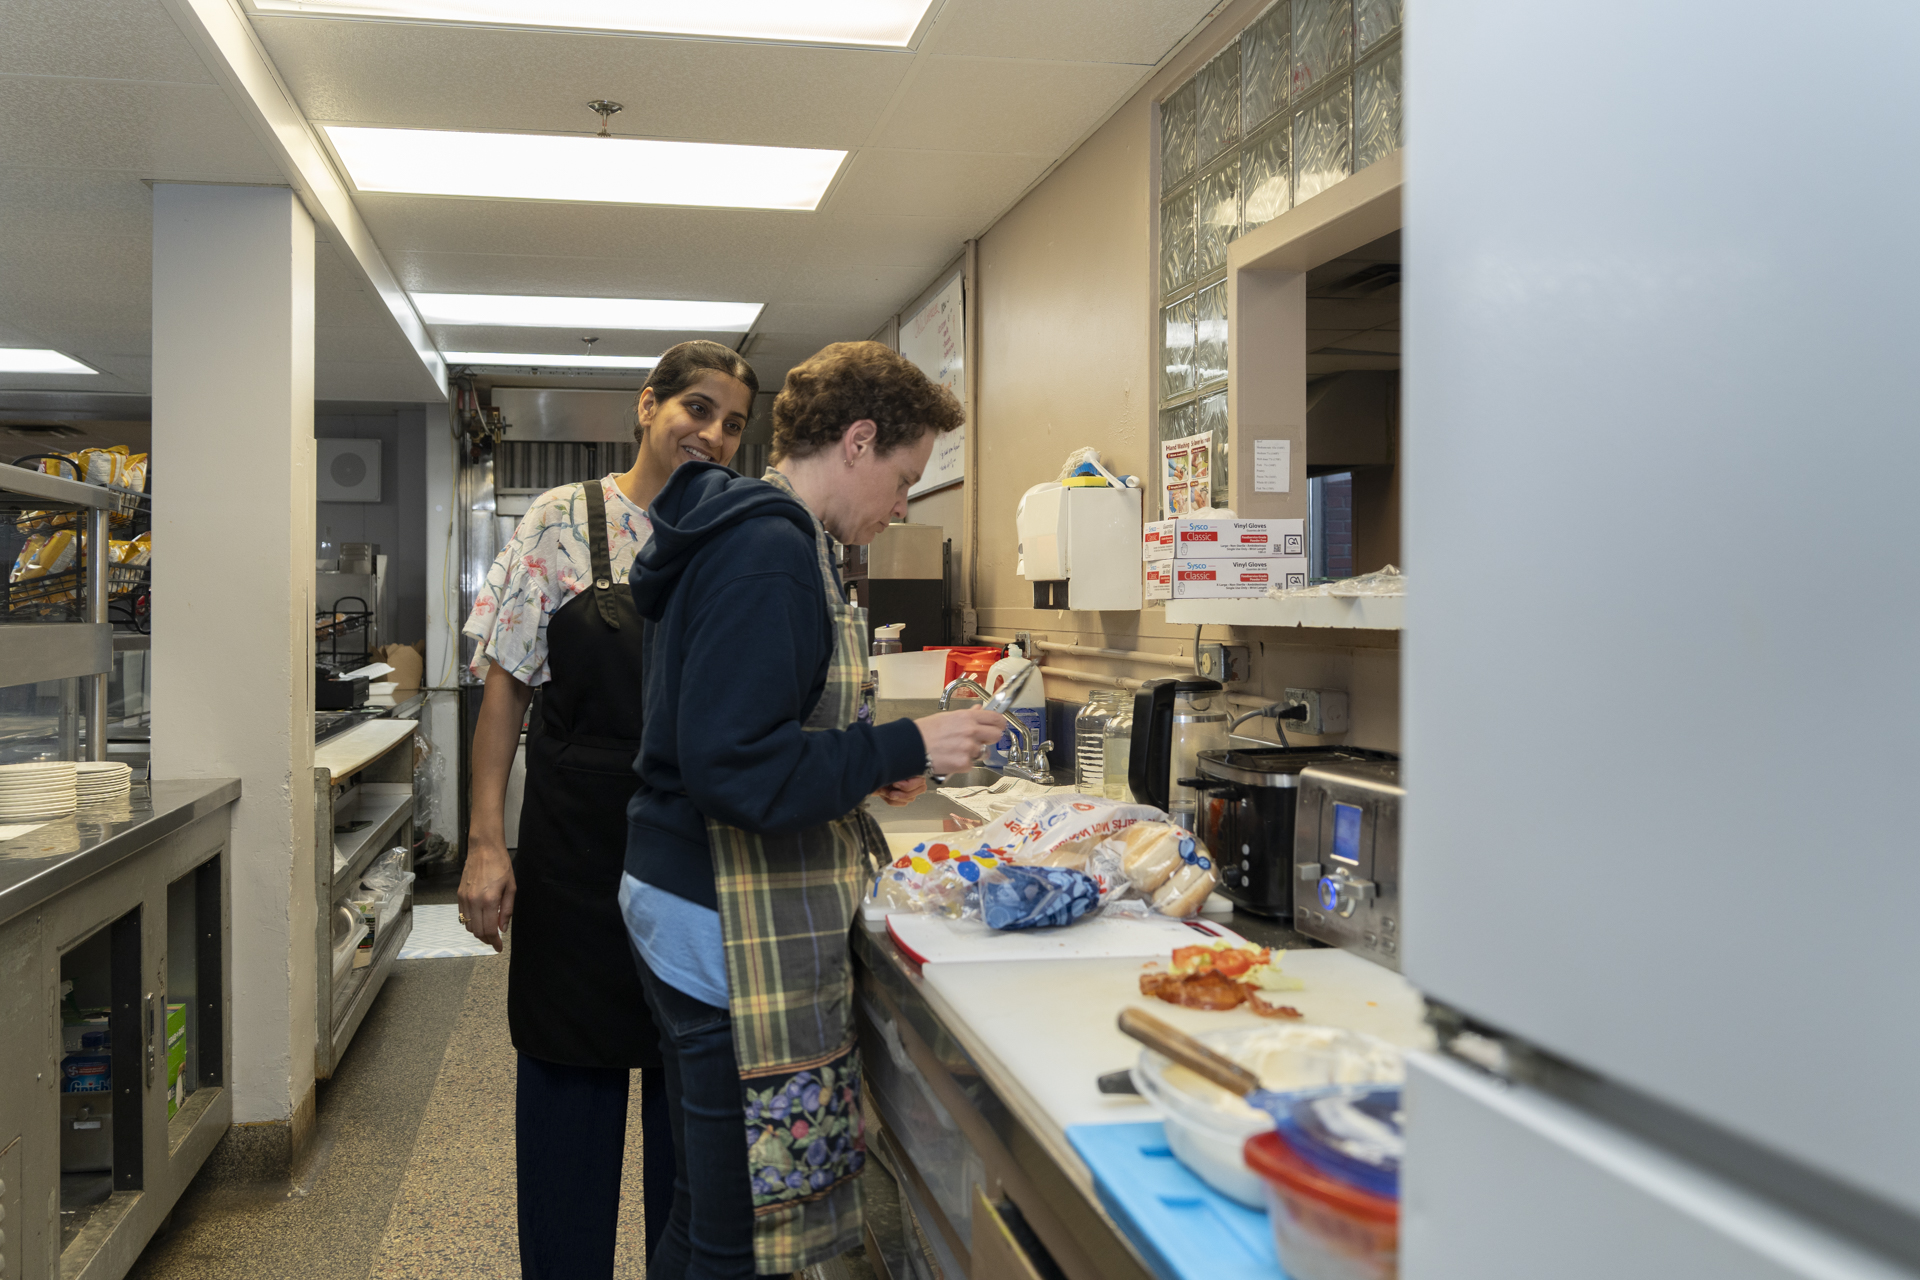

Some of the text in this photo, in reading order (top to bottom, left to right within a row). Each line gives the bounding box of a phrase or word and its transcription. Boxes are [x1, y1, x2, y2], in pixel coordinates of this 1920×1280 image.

[1189, 523, 1208, 531] Sysco
[1187, 533, 1212, 541] Classic
[1187, 562, 1206, 570] Sysco
[1184, 572, 1210, 580] Classic
